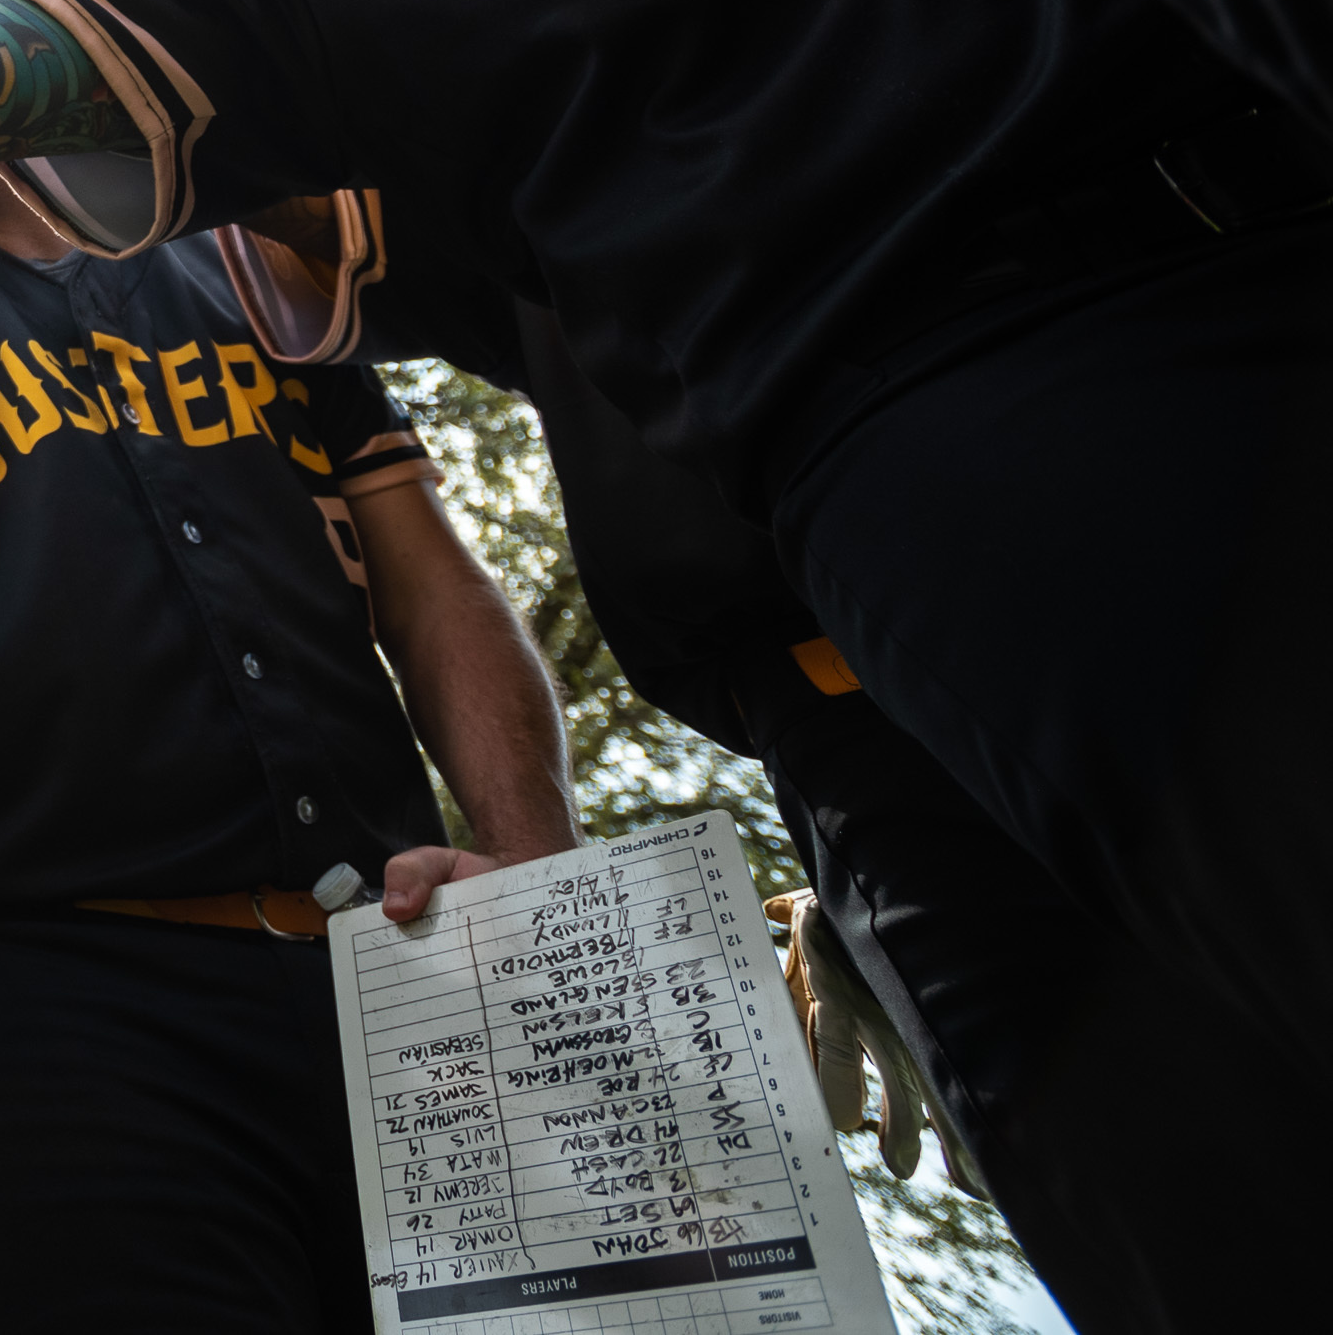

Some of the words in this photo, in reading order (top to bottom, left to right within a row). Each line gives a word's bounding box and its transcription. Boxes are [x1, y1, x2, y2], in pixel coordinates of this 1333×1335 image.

[610, 827, 689, 857] CHAMPRO
[700, 847, 717, 860] 16
[707, 868, 723, 881] 15
[713, 889, 729, 902] 14
[656, 897, 687, 919] LF
[719, 912, 736, 924] 13
[534, 914, 610, 946] LUNDY
[653, 914, 693, 940] RF
[725, 933, 742, 947] 12
[734, 956, 749, 968] 11
[547, 959, 619, 988] LOWE
[510, 976, 629, 1016] ENGLAND
[671, 983, 716, 1006] 3B
[739, 979, 756, 992] 10
[686, 1011, 710, 1029] C
[746, 1004, 755, 1016] 9
[522, 1001, 625, 1041] KELSON
[691, 1029, 722, 1052] 1B
[754, 1028, 762, 1041] 8
[703, 1052, 732, 1079] CF
[762, 1053, 770, 1065] 7
[427, 1061, 484, 1082] JACK
[597, 1071, 640, 1096] ROE
[707, 1080, 727, 1101] P
[768, 1078, 777, 1090] 6
[385, 1093, 407, 1111] 31
[414, 1083, 487, 1110] JAMES
[413, 1104, 494, 1134] JONATHAN
[542, 1099, 649, 1133] CANNON
[709, 1100, 745, 1130] SS
[776, 1103, 786, 1117] 5
[408, 1137, 425, 1156] 19
[450, 1125, 496, 1148] LUIS
[560, 1126, 647, 1155] DREW
[716, 1131, 752, 1155] DH
[784, 1130, 792, 1143] 4
[446, 1150, 502, 1173] MATA
[571, 1150, 645, 1182] CASH
[792, 1156, 801, 1170] 3
[404, 1163, 433, 1184] 34
[669, 1171, 686, 1193] 3
[404, 1186, 421, 1204] 12
[433, 1175, 504, 1203] JEREMY
[584, 1170, 654, 1199] BOYD
[800, 1184, 810, 1198] 2
[406, 1213, 433, 1232] 26
[459, 1199, 508, 1226] PATTY
[600, 1203, 661, 1226] SET
[810, 1213, 818, 1226] 1
[415, 1237, 433, 1257] 14
[448, 1225, 513, 1251] OMAR
[592, 1228, 668, 1257] JOHN
[448, 1251, 518, 1279] XAVIER
[727, 1247, 796, 1268] POSITION
[416, 1262, 436, 1285] 14
[521, 1277, 577, 1295] PLAYERS
[758, 1289, 785, 1300] HOME
[758, 1311, 802, 1325] VISITORS
